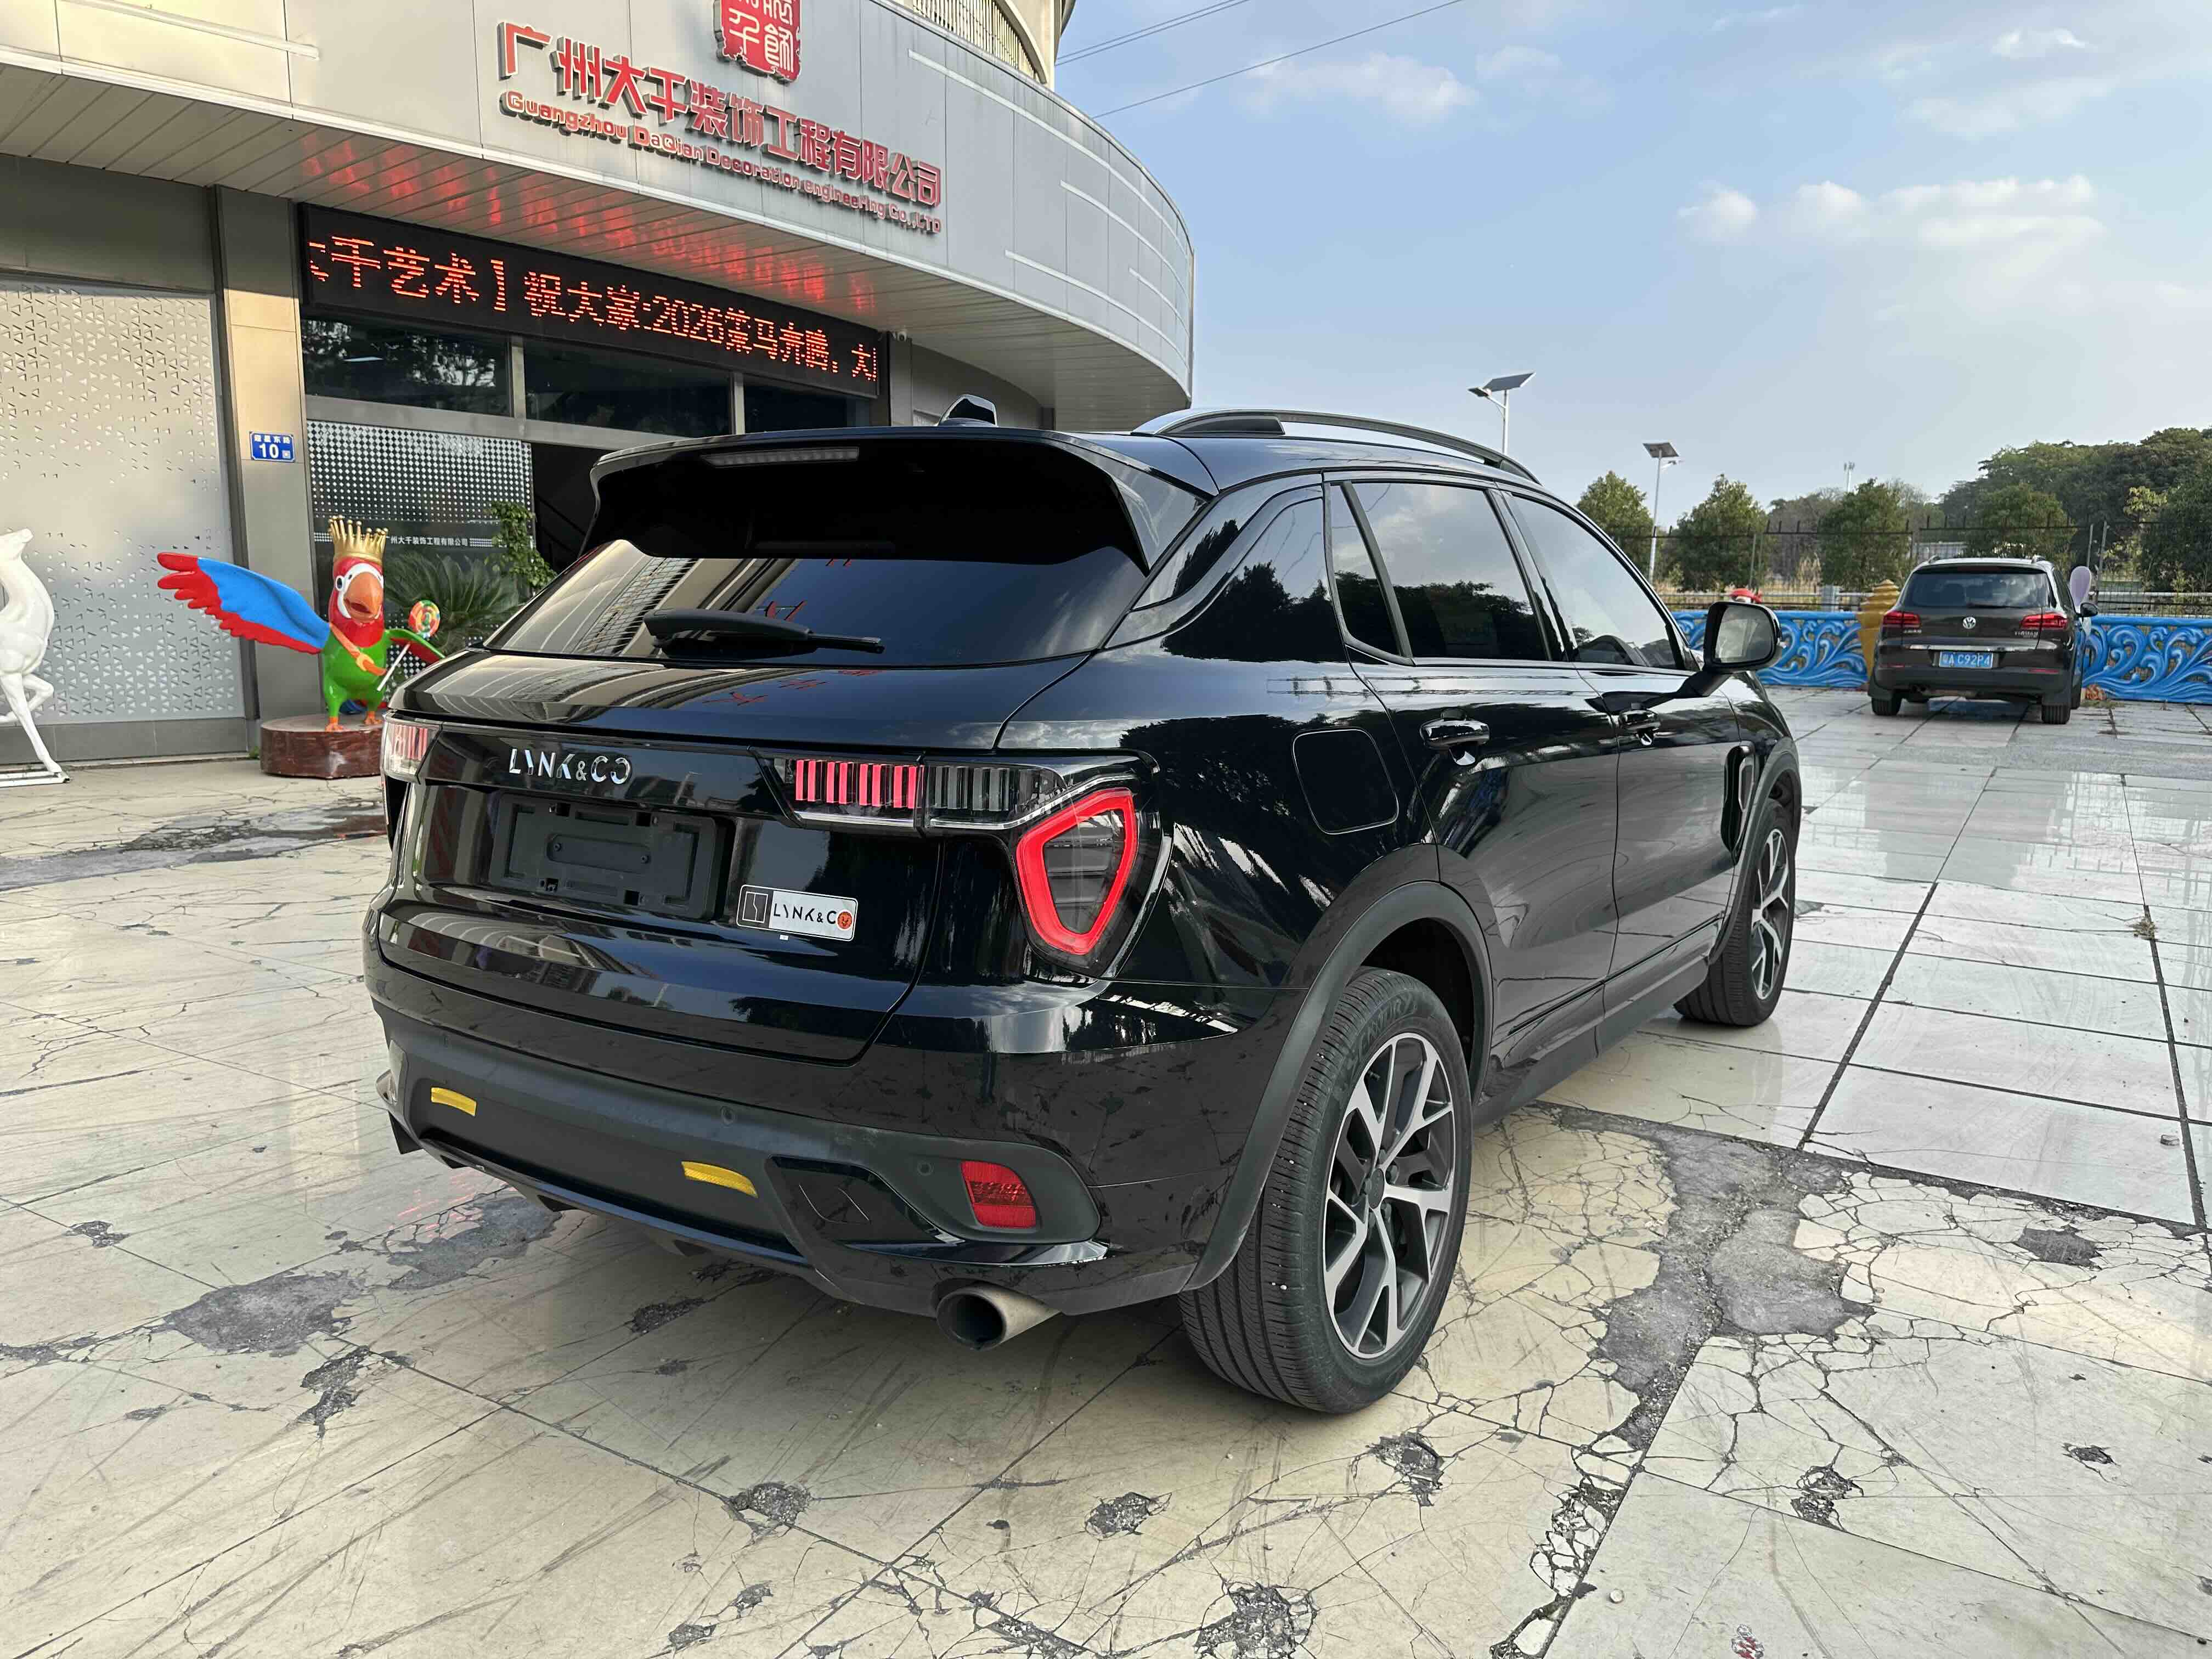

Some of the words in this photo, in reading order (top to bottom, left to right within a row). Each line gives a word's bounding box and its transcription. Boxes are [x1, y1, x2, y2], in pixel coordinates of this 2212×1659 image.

[499, 21, 941, 207] 广州大千装饰工程有限公司
[504, 90, 628, 140] Guangzhou
[632, 125, 704, 161] DaQian
[706, 144, 801, 189] Decoration
[259, 443, 279, 459] 10
[386, 536, 468, 546] 州大千装饰工程有限公司
[509, 748, 631, 785] LYNK&CO
